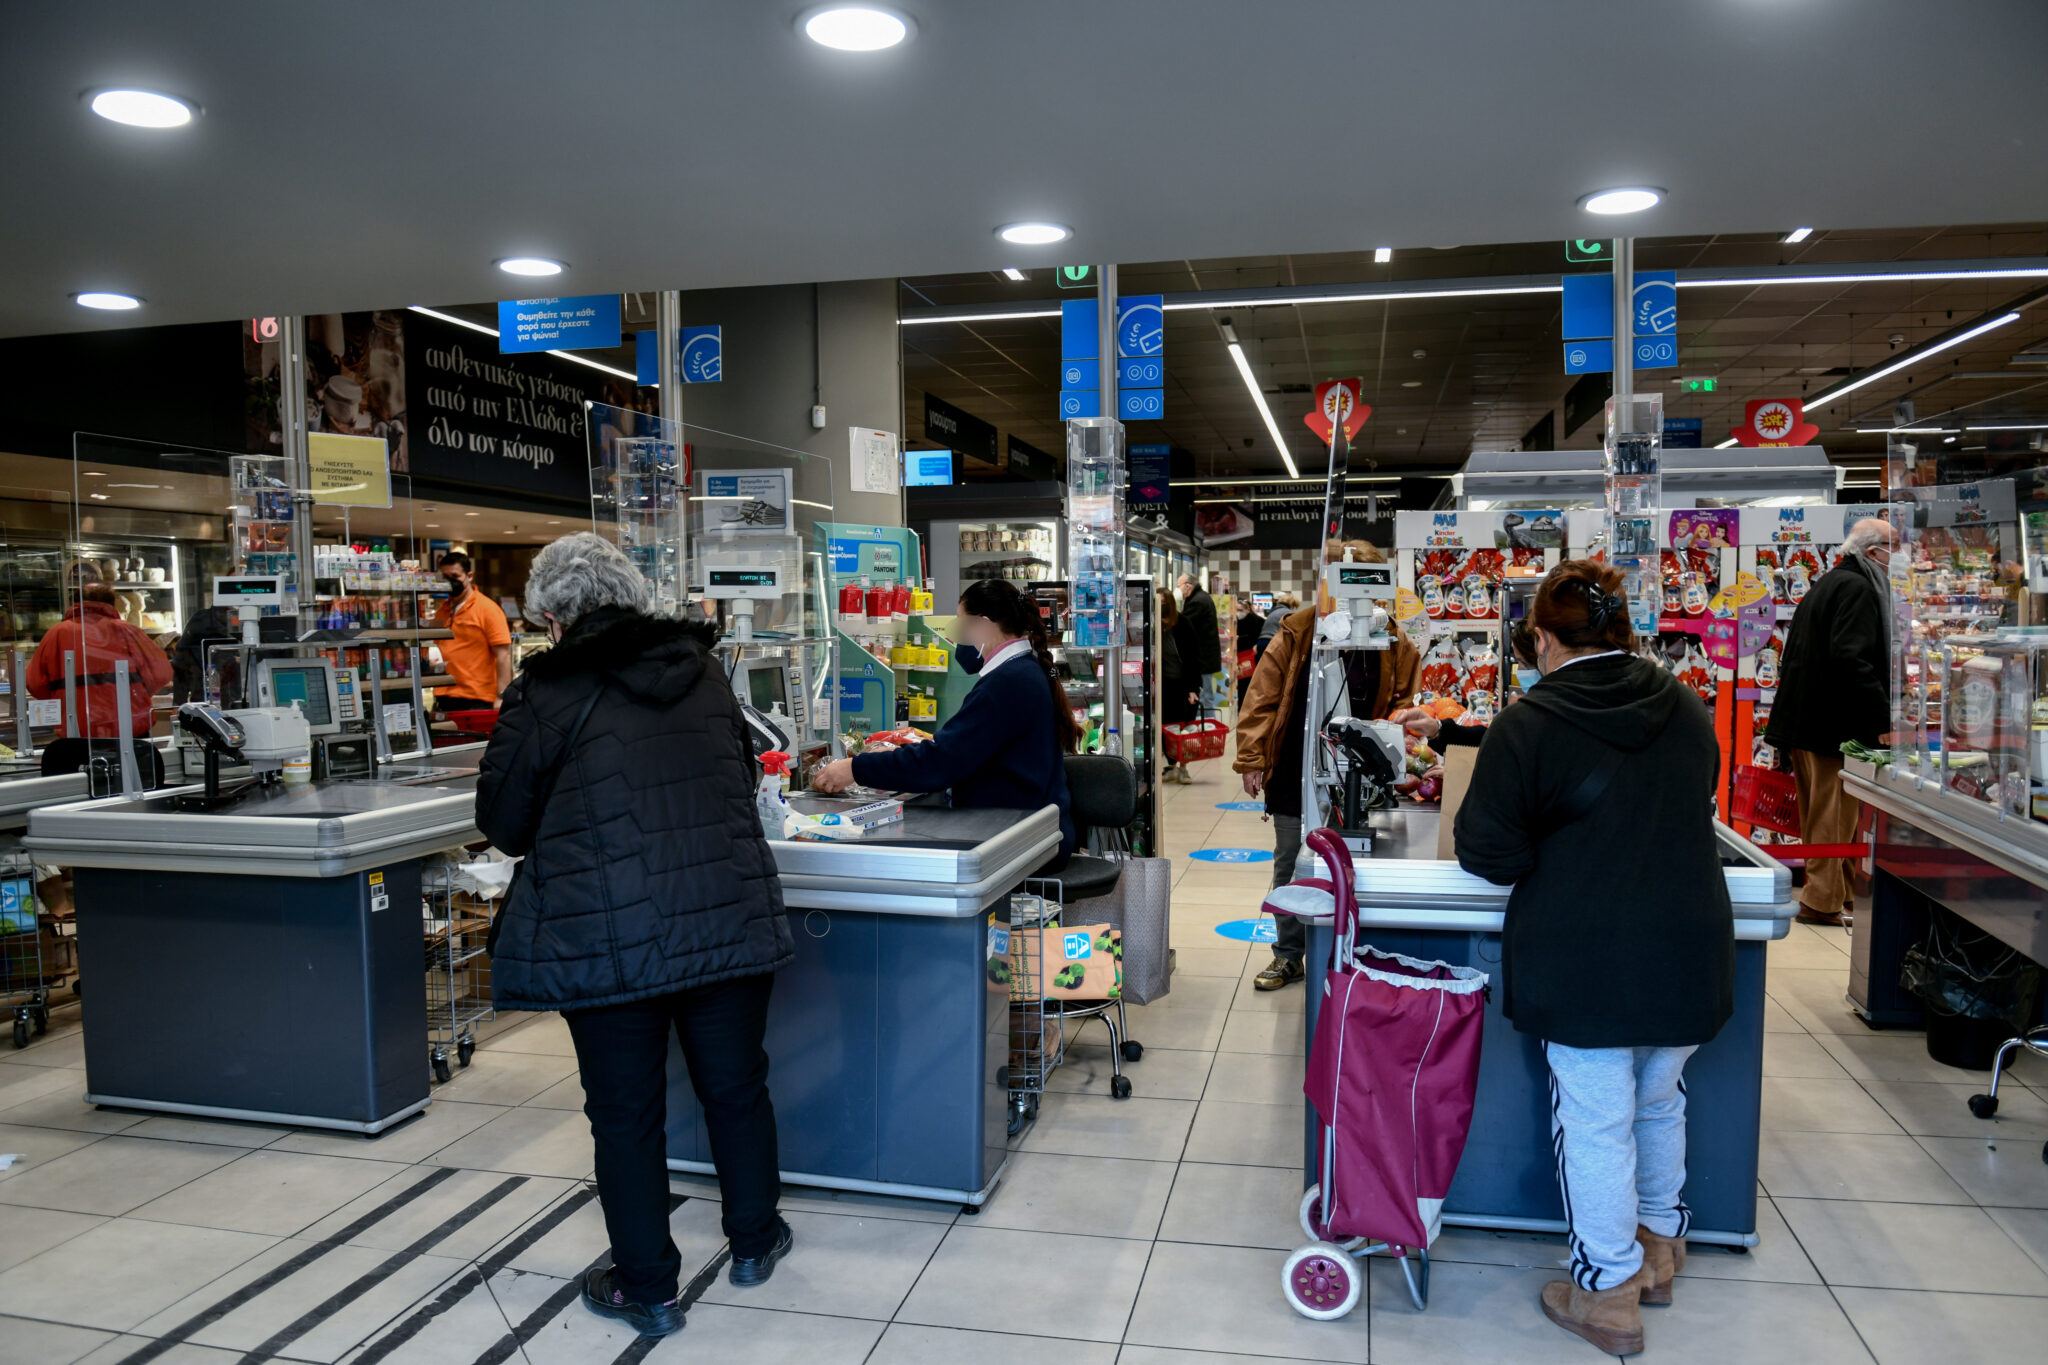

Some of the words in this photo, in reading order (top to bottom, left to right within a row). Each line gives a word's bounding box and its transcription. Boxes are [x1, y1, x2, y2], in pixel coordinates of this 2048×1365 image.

[517, 310, 558, 322] Θυμηθείτε
[560, 311, 573, 320] την
[576, 308, 595, 318] κάθε
[517, 322, 539, 332] φορά
[541, 321, 556, 330] που
[558, 319, 590, 329] έρχεστε
[517, 332, 530, 342] για
[532, 330, 560, 342] ψώνια!
[425, 344, 525, 395] αυθεντικές
[528, 373, 585, 410] γεύσεις
[427, 385, 466, 412] από
[473, 396, 502, 419] την
[506, 396, 567, 434] Ελλάδα
[570, 412, 585, 438] &
[428, 416, 464, 449] όλο
[468, 431, 499, 455] τον
[502, 433, 555, 470] κόσμο
[1156, 513, 1169, 529] &
[1778, 508, 1804, 522] MAXI
[1771, 531, 1812, 542] SURPRISE
